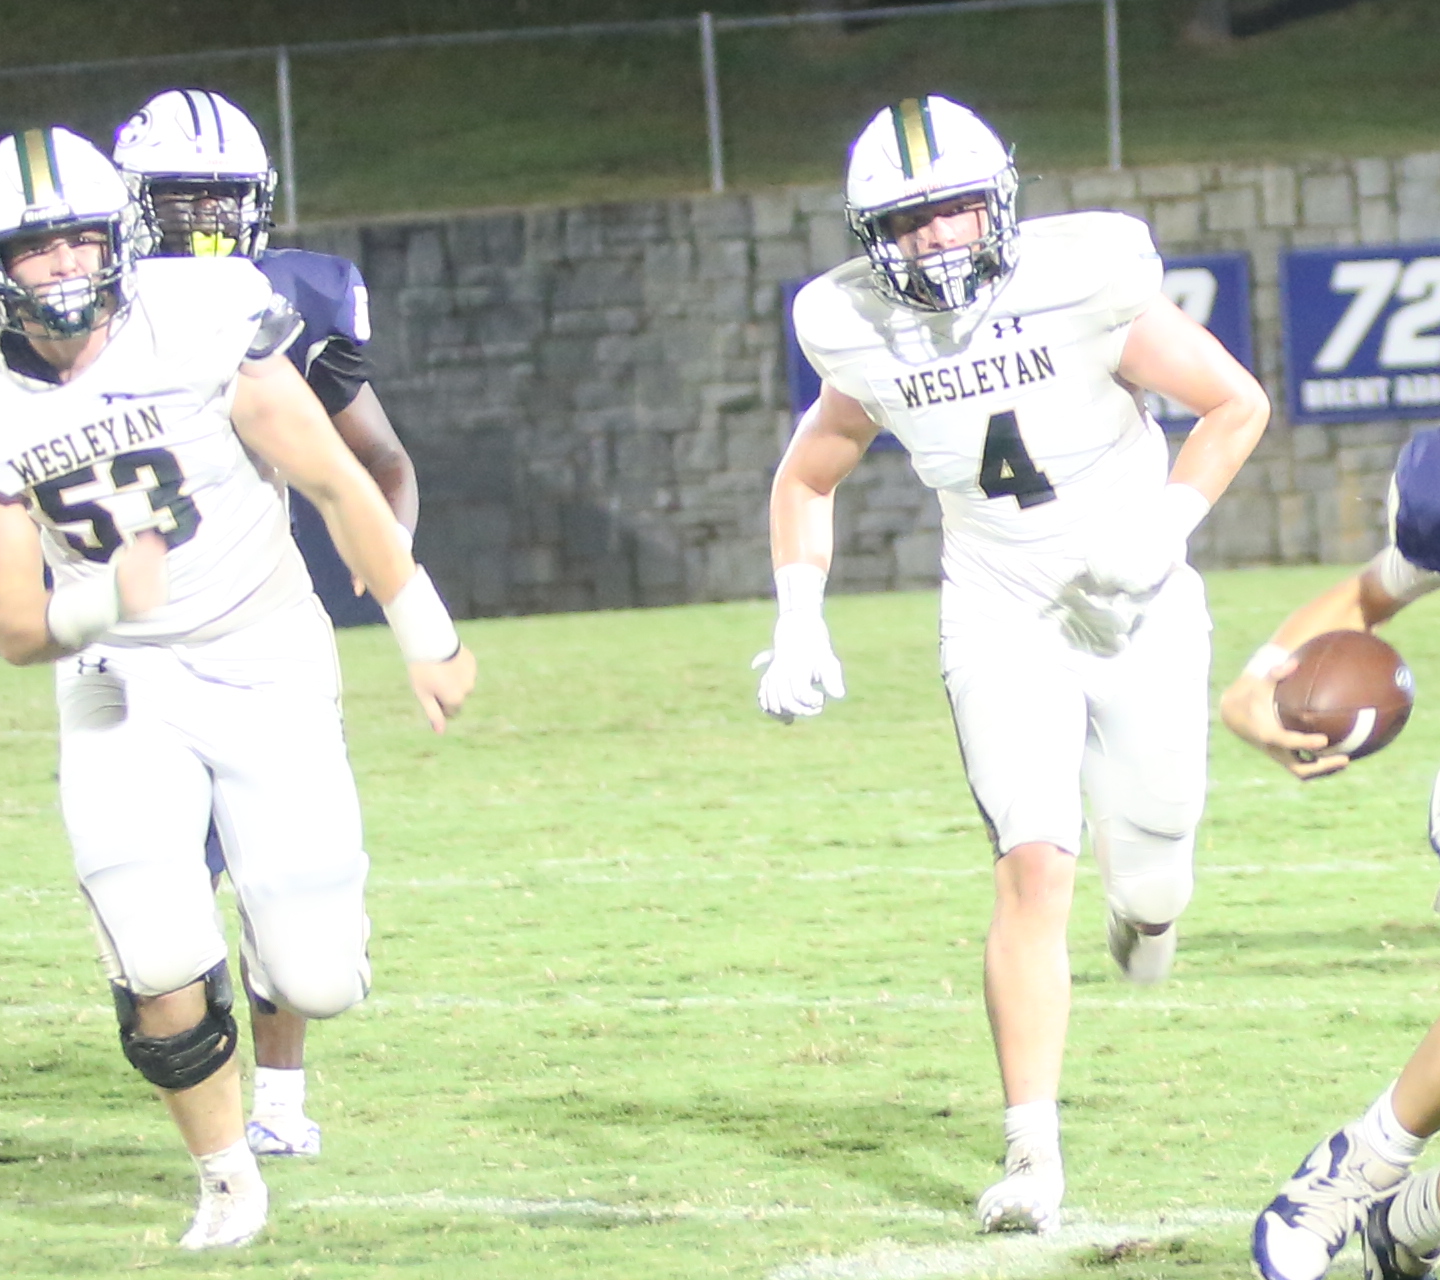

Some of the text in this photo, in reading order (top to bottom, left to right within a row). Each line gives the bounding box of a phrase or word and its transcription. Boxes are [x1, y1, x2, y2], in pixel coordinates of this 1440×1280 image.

[894, 344, 1057, 410] WESLEYAN
[1300, 376, 1391, 413] BRENT
[6, 404, 166, 486] WESLEYAN
[976, 408, 1059, 513] 4
[29, 446, 203, 565] 53
